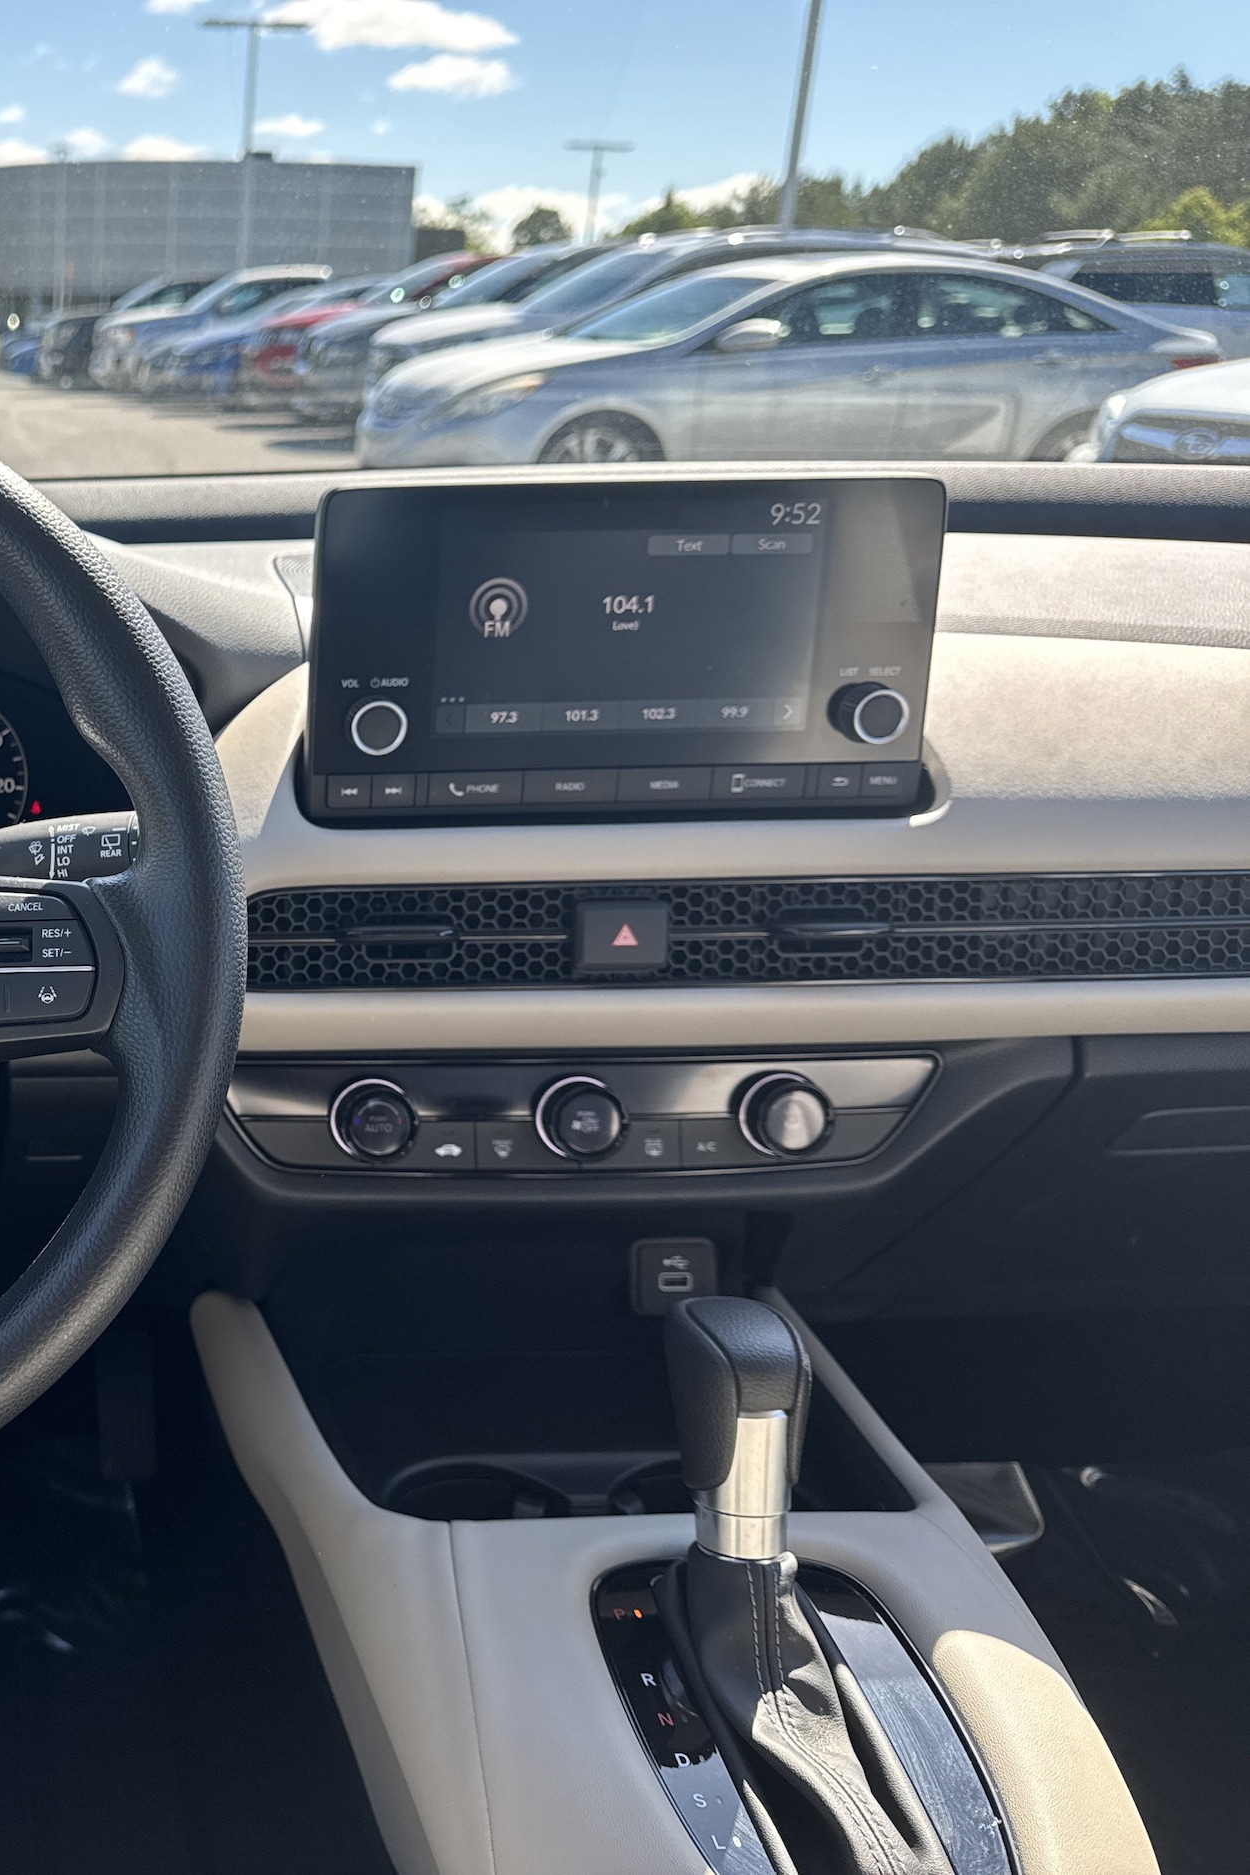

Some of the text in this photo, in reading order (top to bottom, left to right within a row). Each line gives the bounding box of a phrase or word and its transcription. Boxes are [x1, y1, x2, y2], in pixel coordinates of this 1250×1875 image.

[770, 502, 822, 526] 9:52
[676, 539, 703, 553] Text
[758, 537, 786, 551] Scan
[602, 595, 655, 615] 104.1
[484, 620, 511, 638] FM
[869, 665, 902, 677] SELECT
[341, 678, 359, 689] VOL
[381, 676, 410, 688] AUDIO
[555, 781, 586, 792] RADIO
[649, 779, 679, 790] MEDIA
[744, 776, 787, 789] CONNECT
[869, 775, 898, 787] MENU
[465, 782, 500, 794] PHONE
[56, 823, 80, 833] MIST
[56, 833, 76, 844] OFF
[56, 844, 74, 855] INT
[100, 848, 122, 859] REAR
[56, 856, 71, 867] LO
[56, 869, 69, 879] HI
[7, 901, 44, 913] CANCEL
[363, 1122, 394, 1134] AUTO
[613, 1608, 626, 1620] P
[640, 1673, 657, 1687] R
[657, 1712, 675, 1727] N
[674, 1752, 691, 1767] D
[692, 1793, 707, 1808] S
[711, 1834, 727, 1850] L
